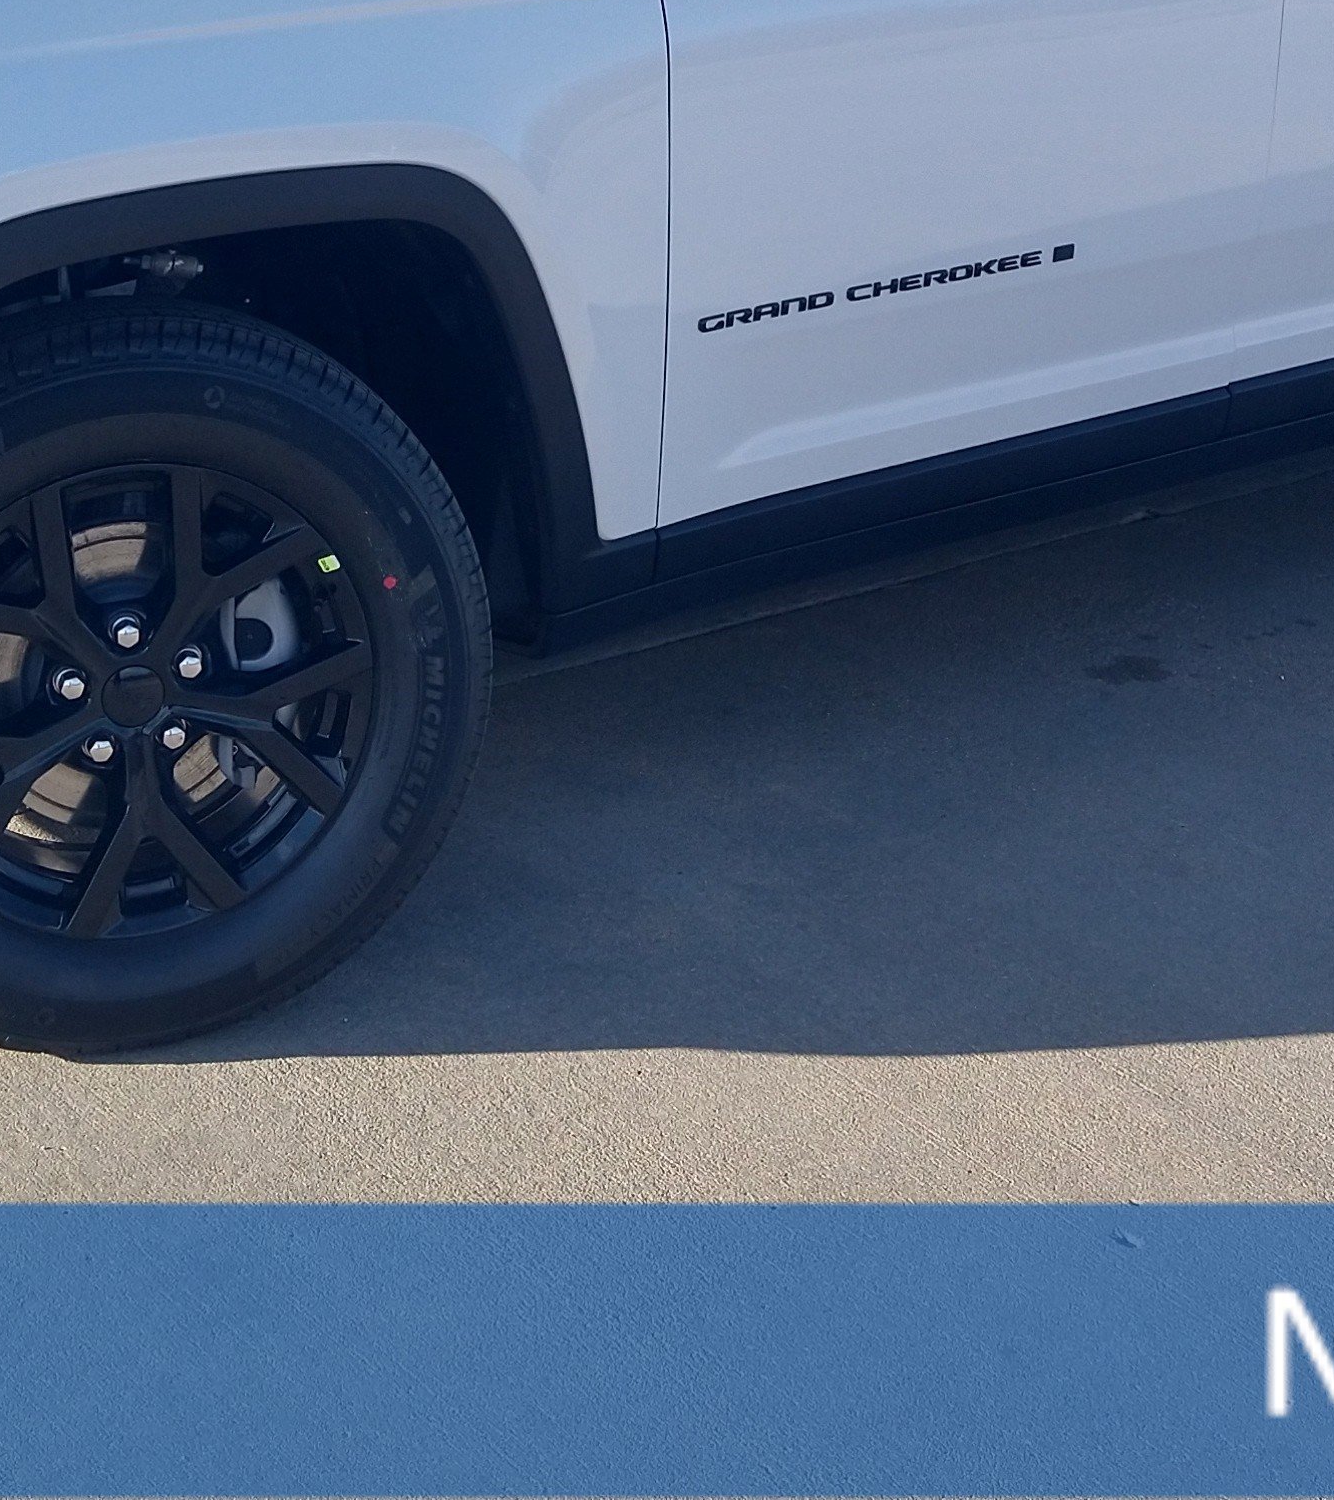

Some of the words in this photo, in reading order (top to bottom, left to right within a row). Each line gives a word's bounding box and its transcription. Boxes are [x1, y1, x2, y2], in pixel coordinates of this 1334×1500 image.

[697, 291, 835, 334] GRAND
[846, 249, 1043, 302] CHEROKEE
[387, 655, 446, 836] MICHELIN
